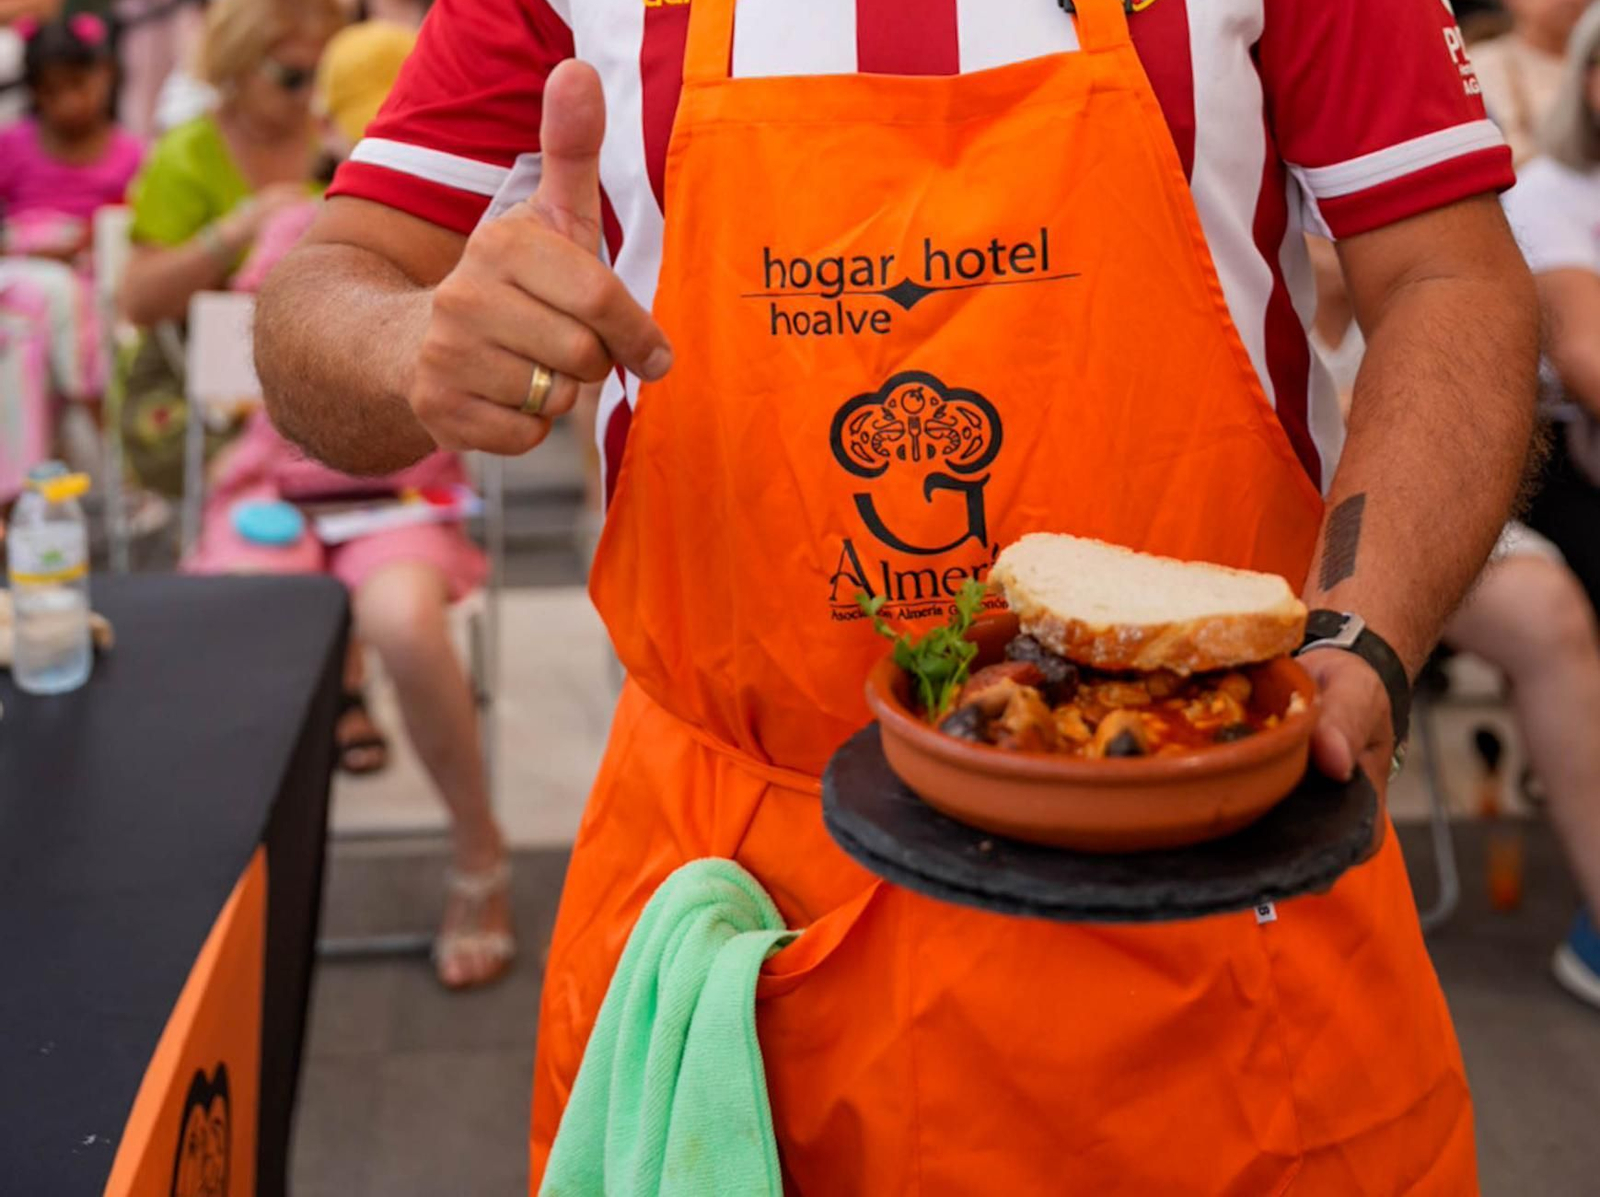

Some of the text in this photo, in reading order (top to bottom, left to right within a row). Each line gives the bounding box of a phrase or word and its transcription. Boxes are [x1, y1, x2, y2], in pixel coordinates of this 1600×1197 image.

[763, 227, 1050, 298] hogar hotel
[770, 300, 892, 336] hoalve
[829, 538, 999, 602] Almer
